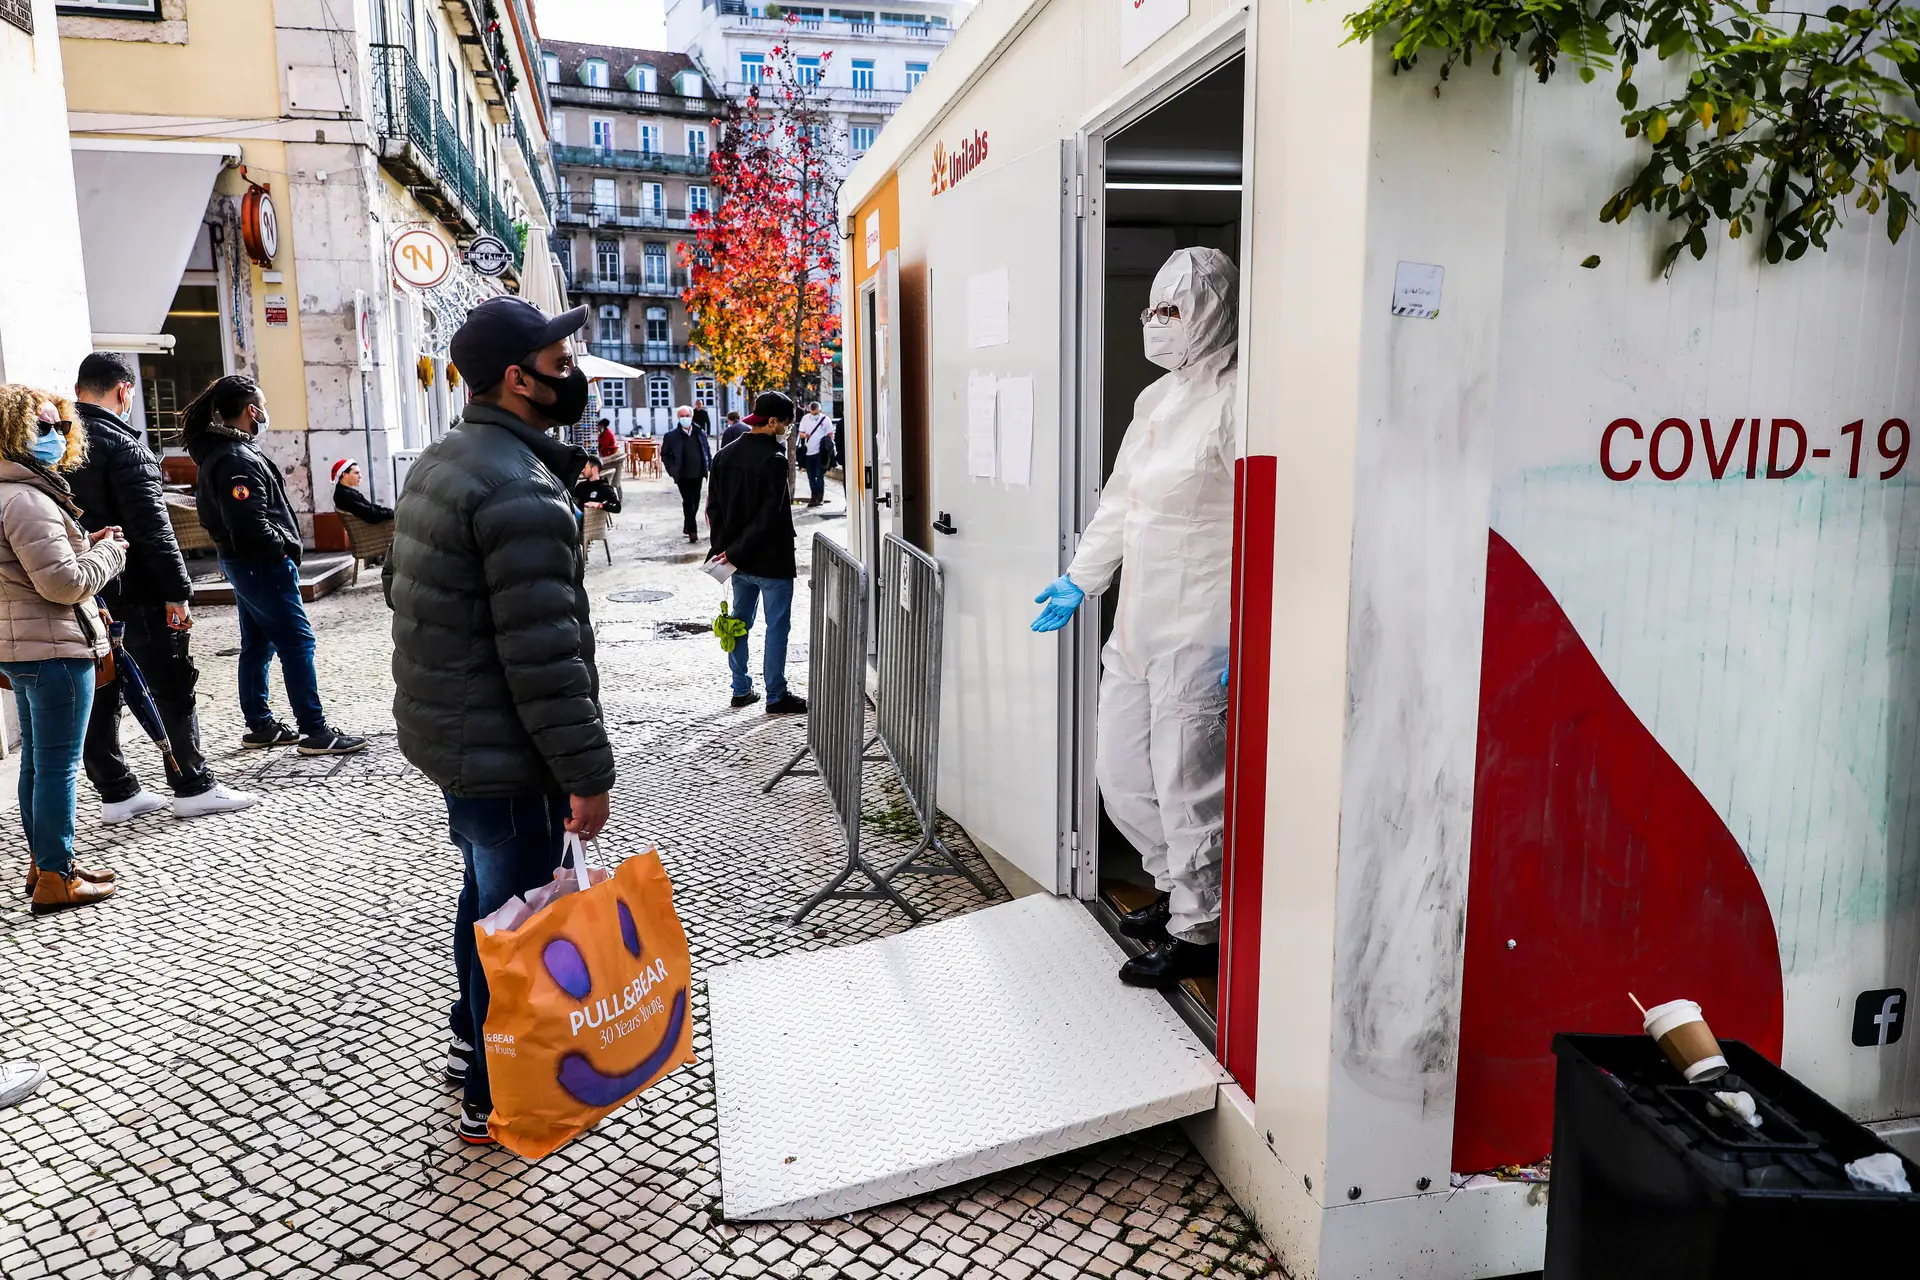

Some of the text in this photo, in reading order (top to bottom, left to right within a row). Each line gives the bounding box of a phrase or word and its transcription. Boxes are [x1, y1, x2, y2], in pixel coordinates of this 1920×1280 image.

[949, 129, 988, 188] Unilabs
[402, 244, 434, 272] N
[1600, 418, 1911, 481] COVID-19
[569, 957, 668, 1036] PULL&BEAR
[599, 995, 664, 1049] 30 Years Young
